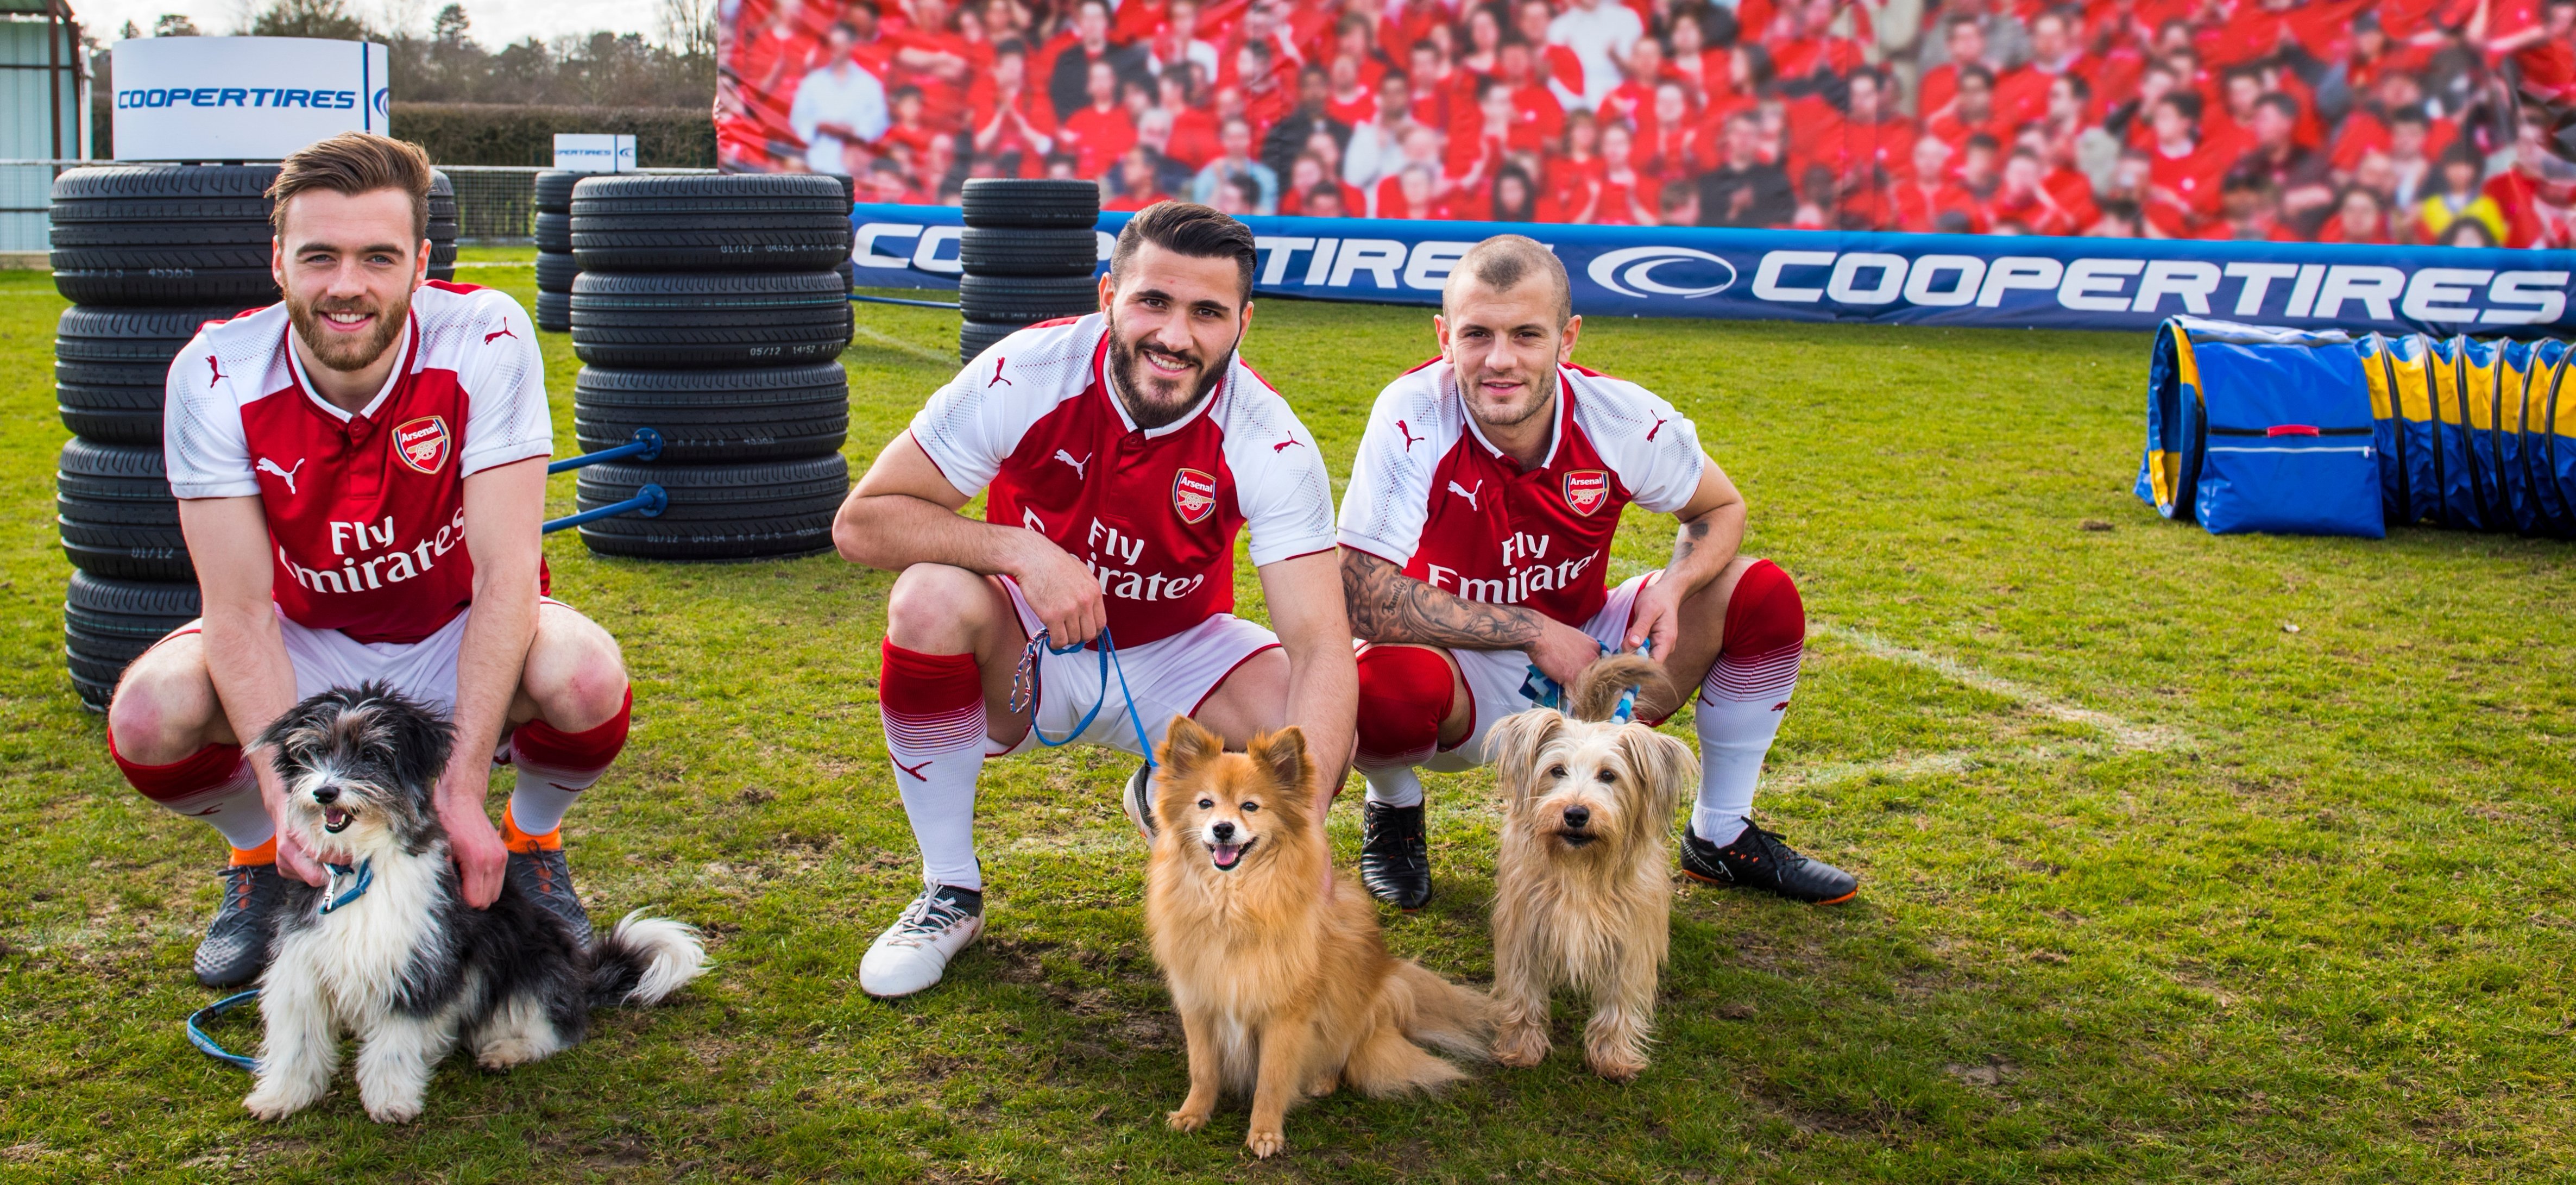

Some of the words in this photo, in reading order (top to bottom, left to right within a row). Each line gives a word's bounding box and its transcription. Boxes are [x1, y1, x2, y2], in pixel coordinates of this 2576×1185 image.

[118, 88, 356, 109] COOPERTIRES
[1752, 250, 2570, 324] COOPERTIRES
[402, 423, 438, 443] Arsenal
[1181, 476, 1213, 493] Arsenal
[1570, 477, 1602, 485] Arsenal
[330, 516, 394, 555] Fly
[1088, 516, 1144, 566] Fly
[1502, 531, 1549, 567] Fly
